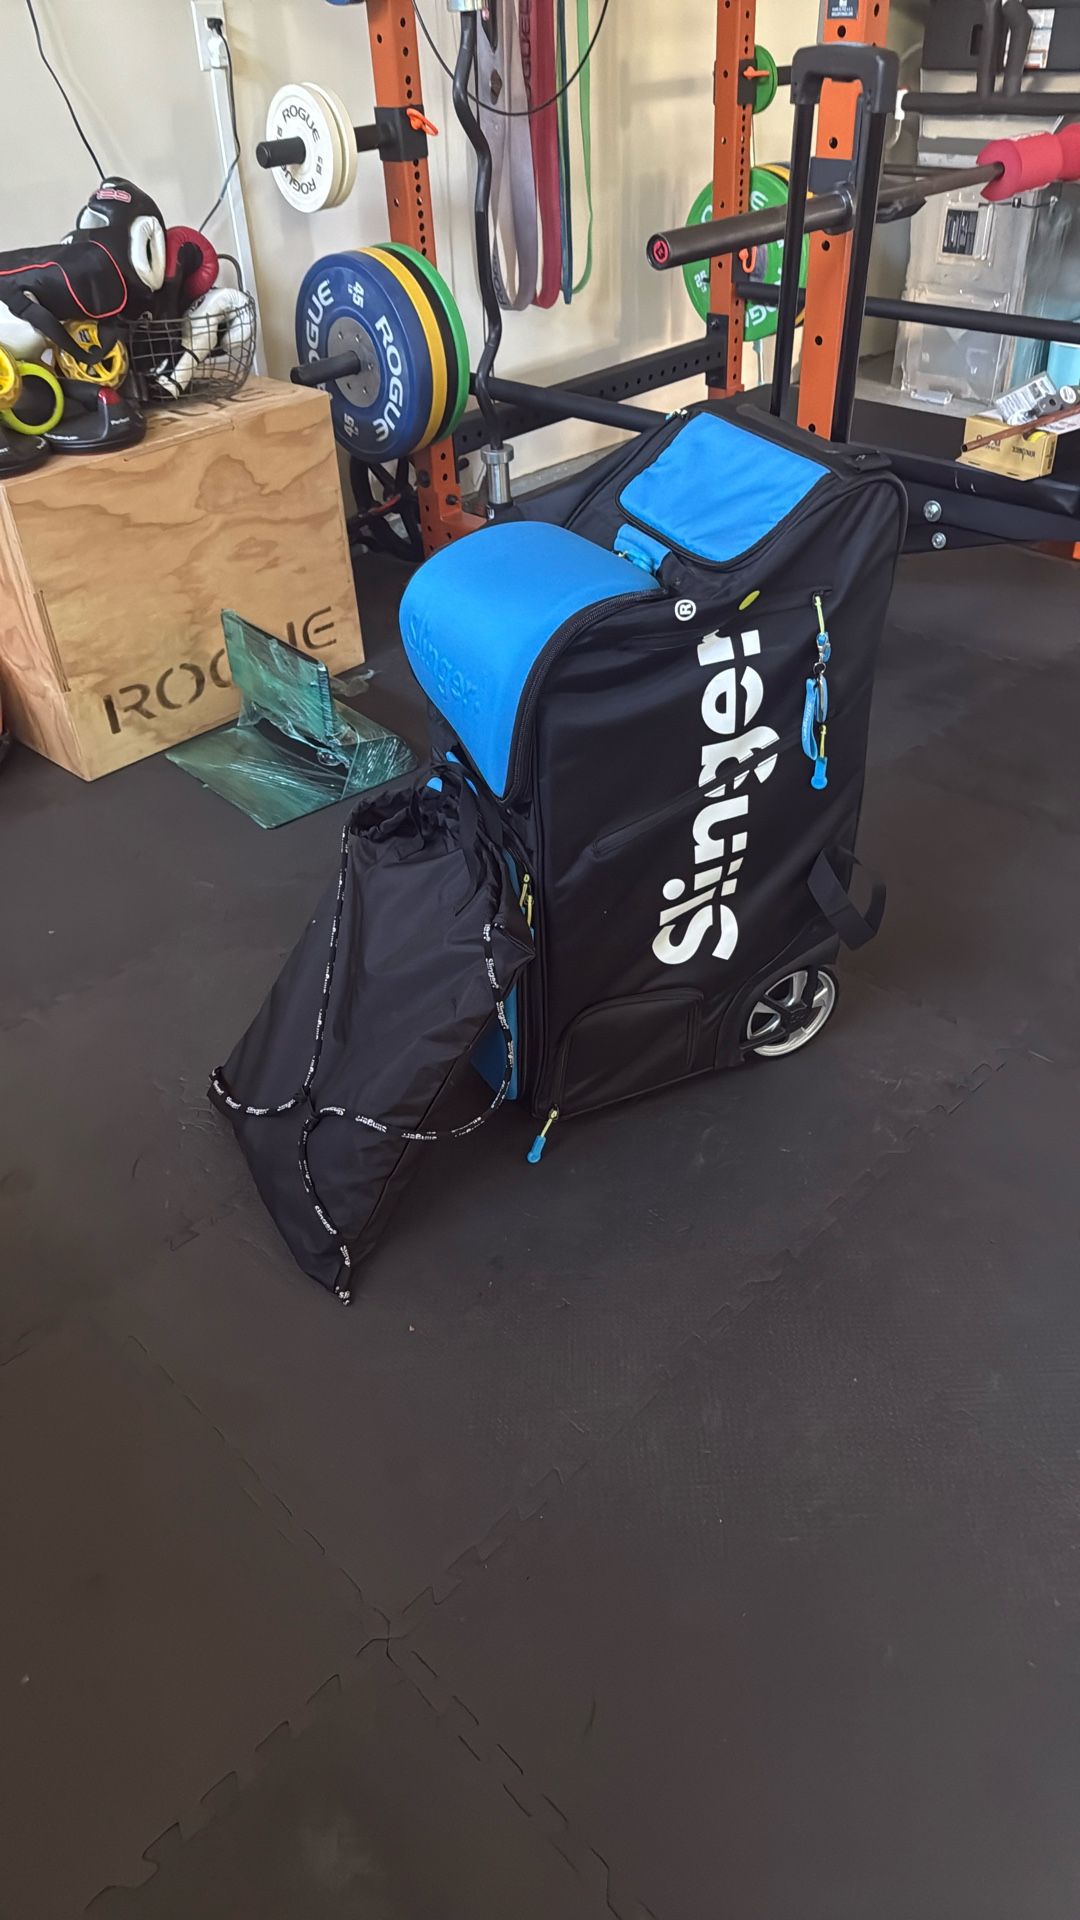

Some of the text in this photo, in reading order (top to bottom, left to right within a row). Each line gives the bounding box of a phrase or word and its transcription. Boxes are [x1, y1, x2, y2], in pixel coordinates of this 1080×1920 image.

[282, 104, 321, 144] ROGUE
[351, 281, 365, 309] 45
[374, 315, 403, 442] ROGUE
